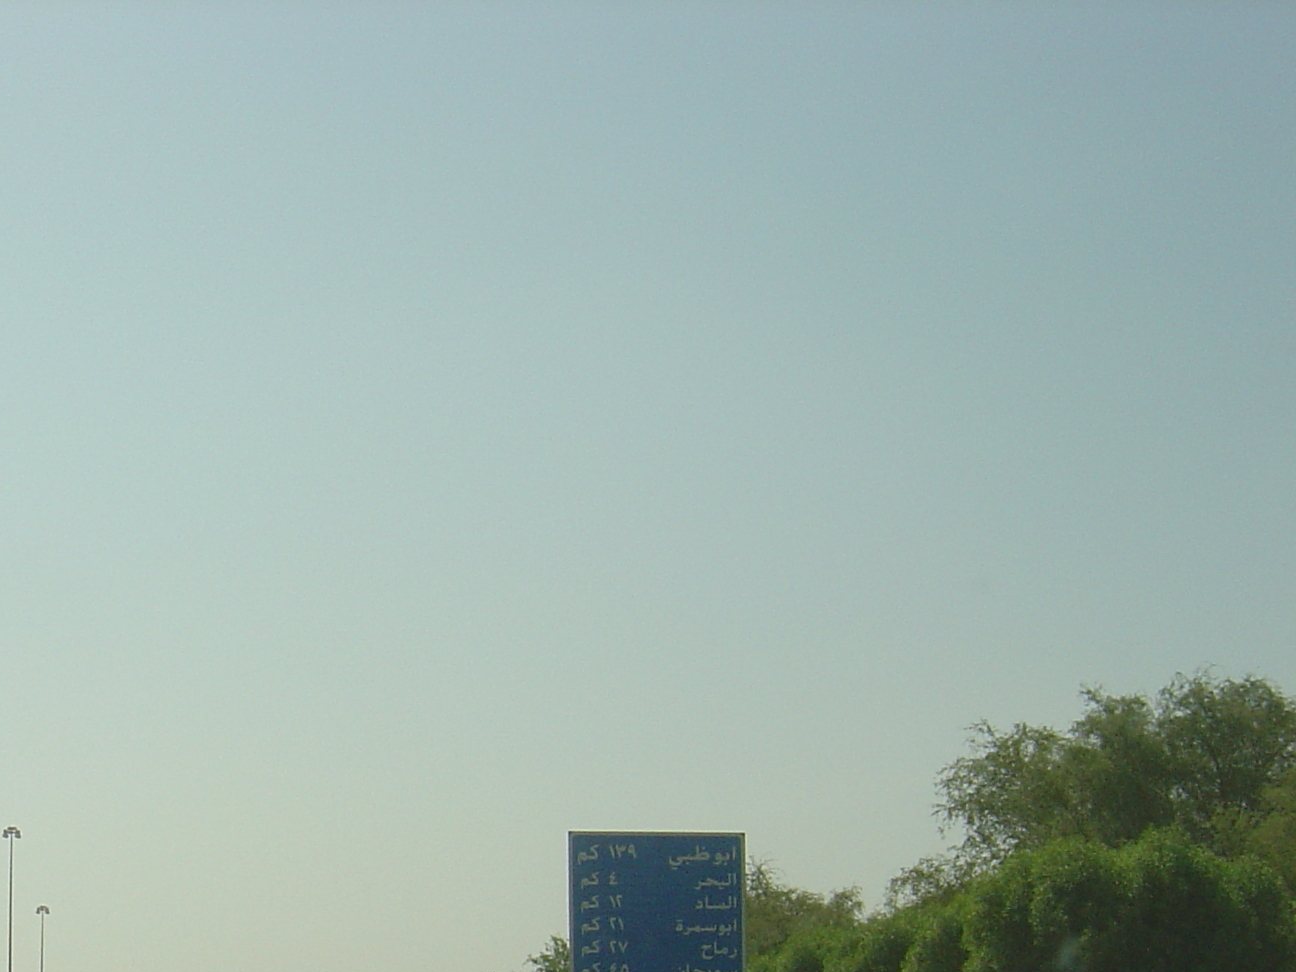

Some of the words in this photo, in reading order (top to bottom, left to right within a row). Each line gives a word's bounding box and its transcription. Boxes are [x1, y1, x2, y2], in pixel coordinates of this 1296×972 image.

[577, 844, 600, 865] كم
[580, 871, 600, 889] كم
[609, 872, 618, 885] ٤
[580, 895, 600, 912] كم
[581, 917, 601, 935] كم
[581, 940, 601, 957] كم
